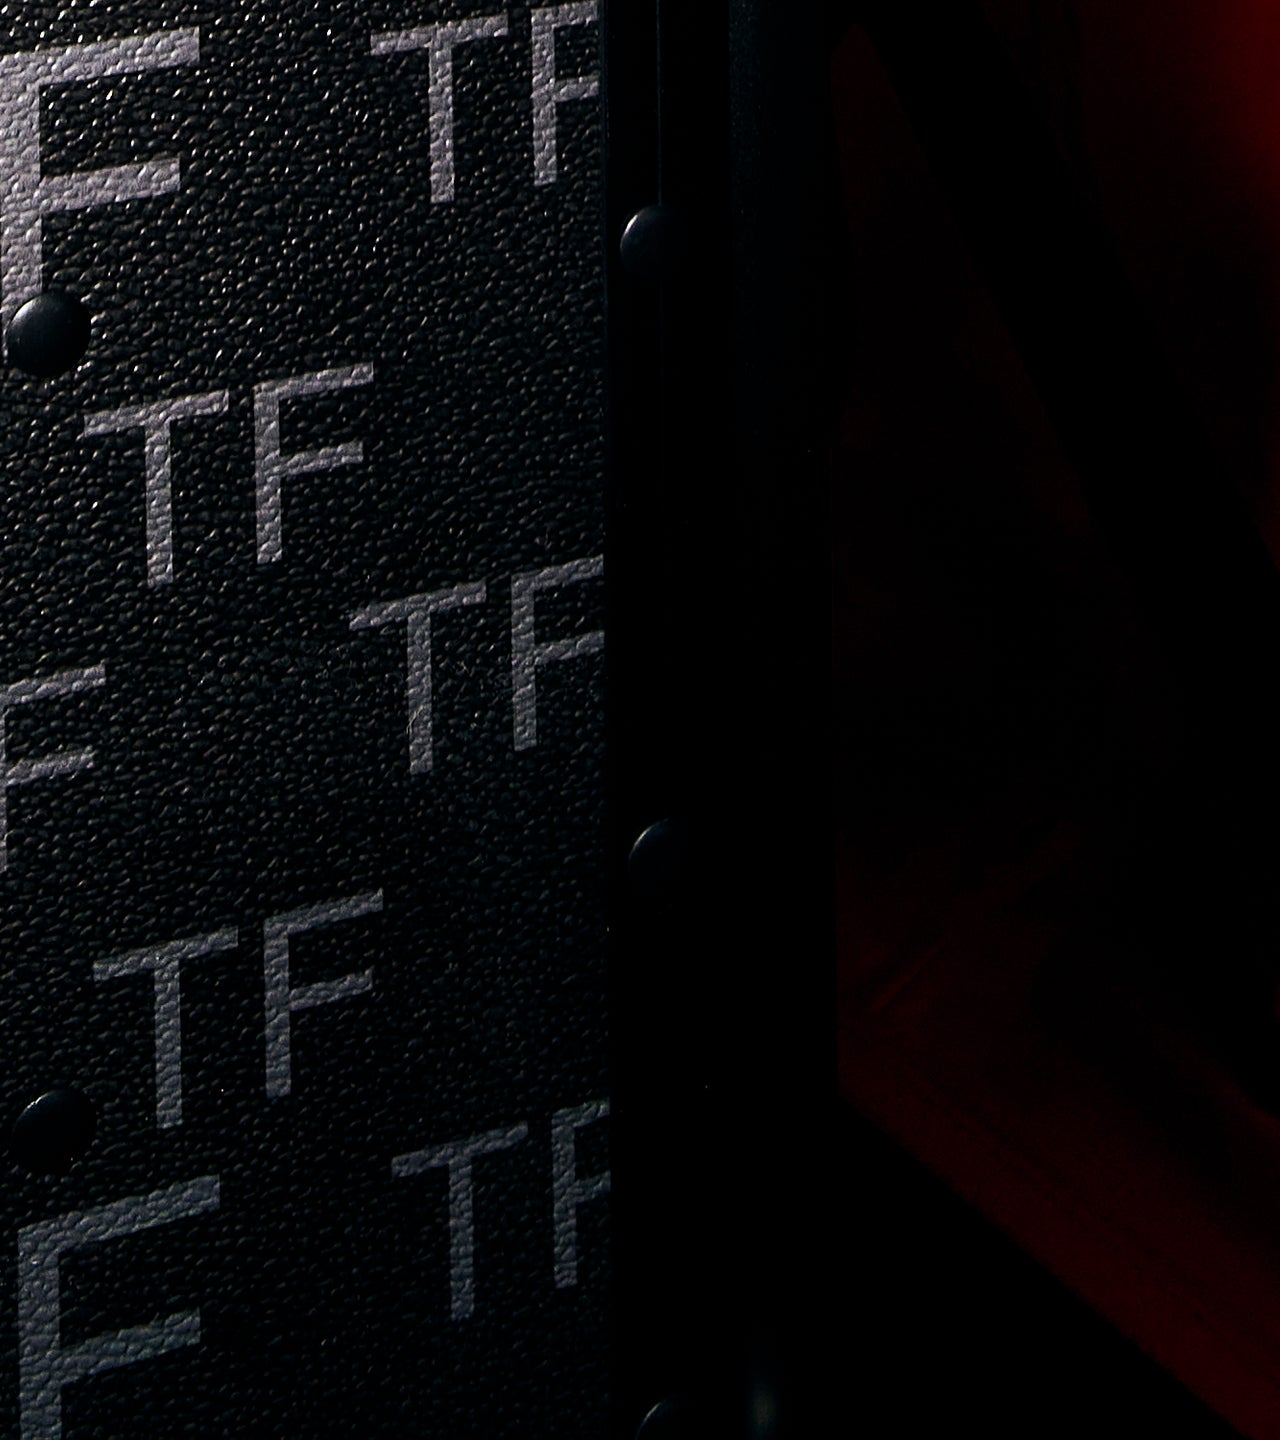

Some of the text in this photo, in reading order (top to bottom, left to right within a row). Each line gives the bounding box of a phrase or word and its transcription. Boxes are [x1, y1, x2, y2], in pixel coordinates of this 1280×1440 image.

[83, 360, 375, 589] TF
[348, 552, 605, 776] TF
[92, 887, 384, 1130] TF
[390, 1096, 612, 1322] TF
